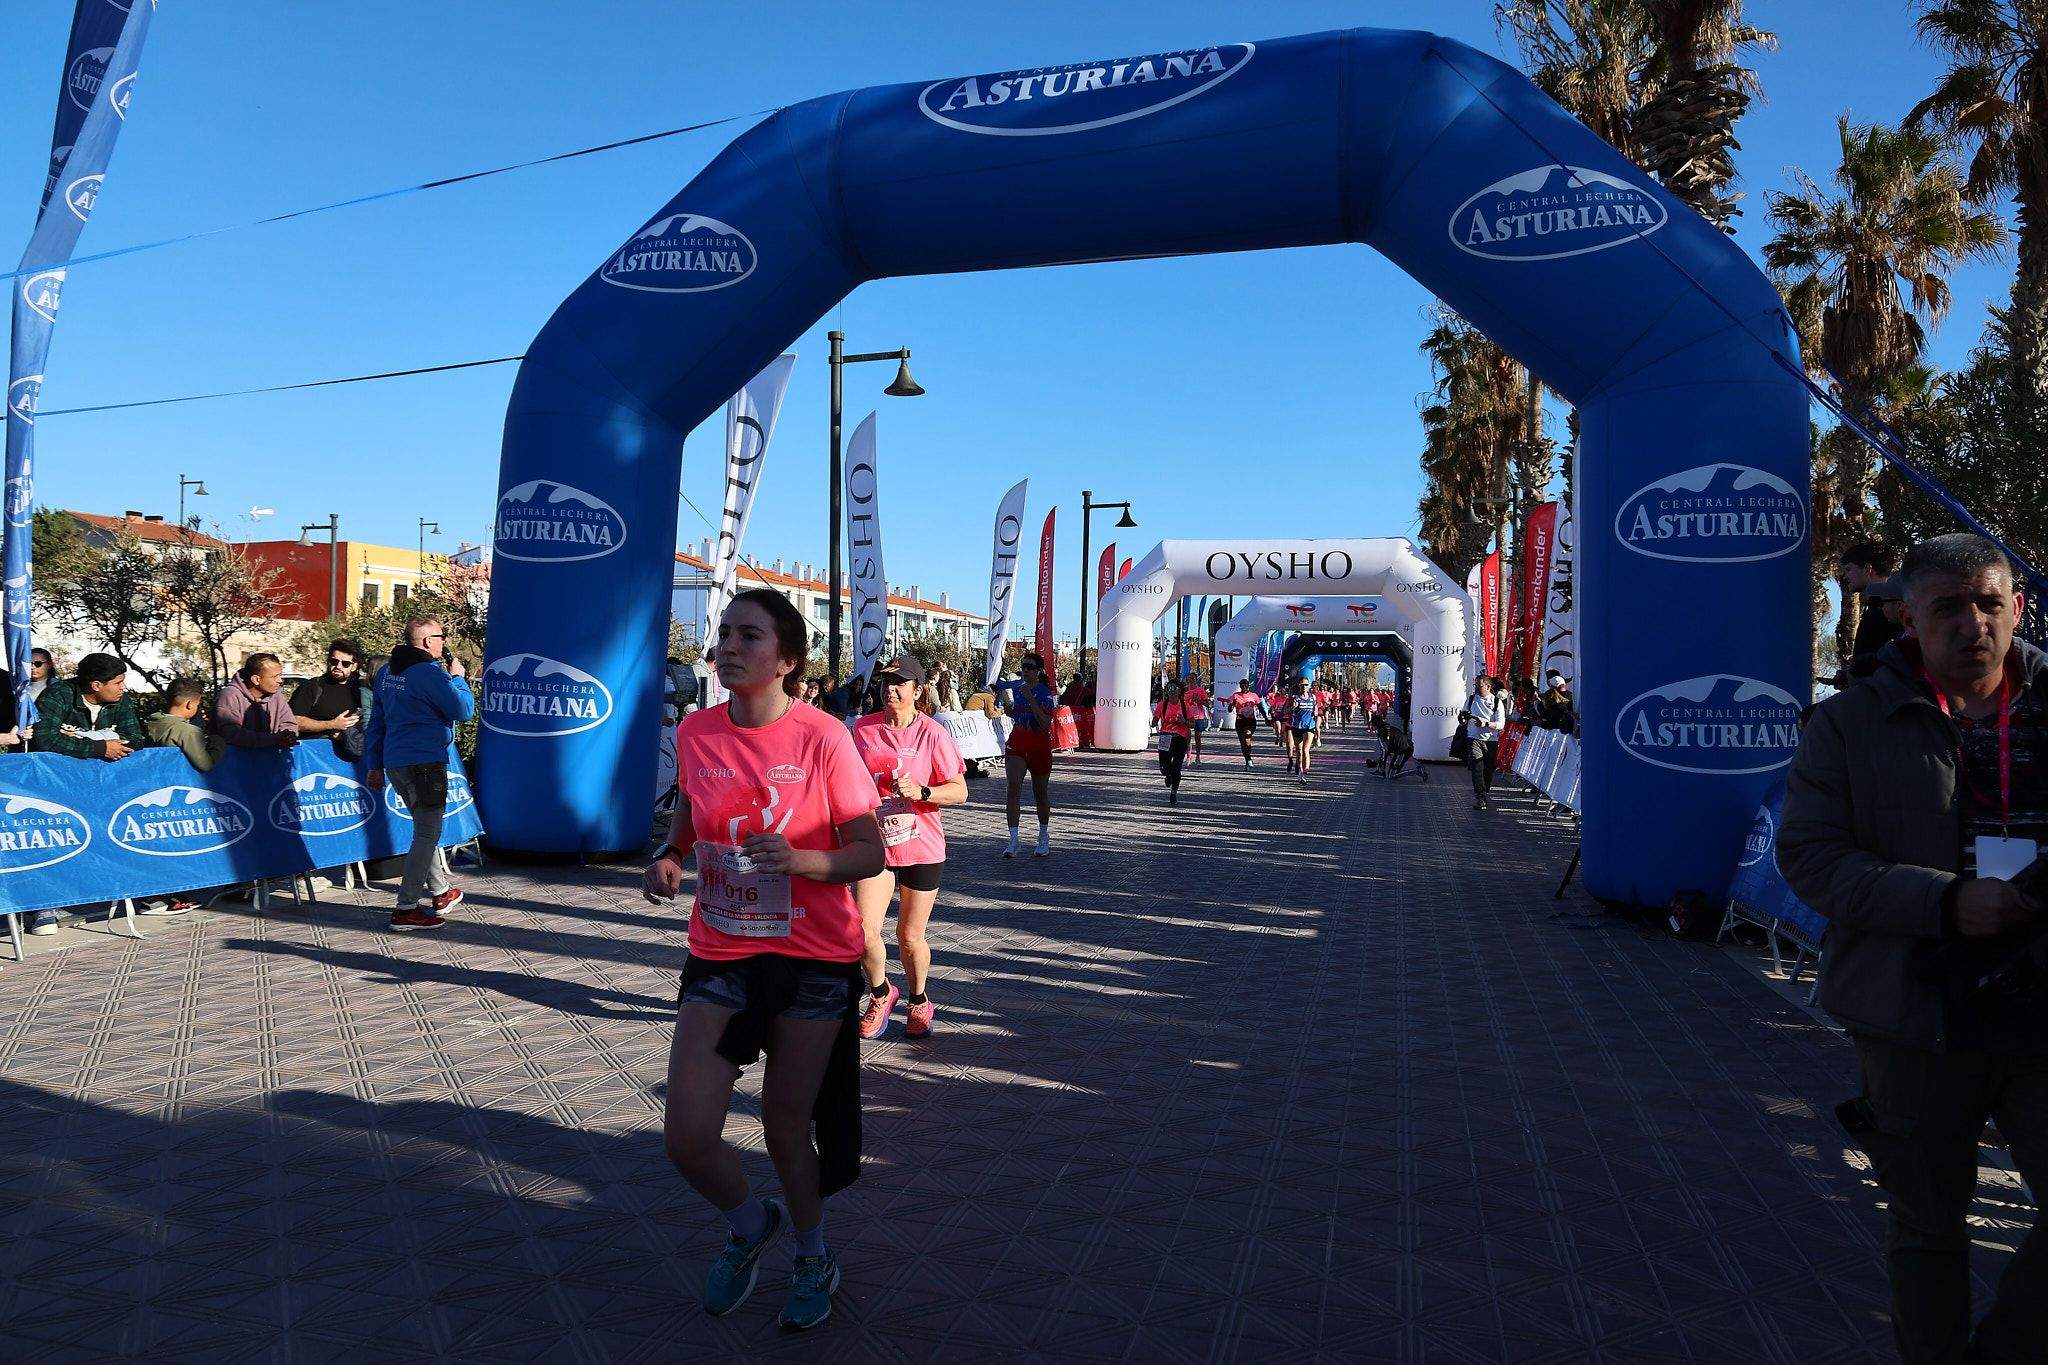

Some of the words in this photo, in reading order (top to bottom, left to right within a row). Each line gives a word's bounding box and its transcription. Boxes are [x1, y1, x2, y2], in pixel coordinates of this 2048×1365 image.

[939, 47, 1226, 112] ASTURIANA
[1497, 195, 1569, 212] CENTRAL
[1576, 192, 1643, 203] LECHERA
[1466, 204, 1655, 245] ASTURIANA
[633, 238, 678, 250] CENTRAL
[683, 238, 738, 248] LECHERA
[606, 250, 743, 276] ASTURIANA
[1661, 498, 1733, 510] CENTRAL
[1740, 497, 1796, 510] LECHERA
[505, 507, 547, 516] CENTRAL
[552, 508, 609, 521] LECHERA
[495, 510, 613, 546] ASTURIANA
[1628, 504, 1799, 541] ASTURIANA
[850, 463, 882, 660] OYSHO
[1206, 551, 1352, 580] OYSHO
[1530, 527, 1546, 617] Santander
[1122, 584, 1163, 594] OYSHO
[1396, 582, 1443, 593] OYSHO
[1101, 640, 1139, 650] OYSHO
[1421, 645, 1465, 655] OYSHO
[491, 680, 532, 690] CENTRAL
[538, 684, 595, 694] LECHERA
[481, 681, 599, 719] ASTURIANA
[1099, 697, 1137, 708] OYSHO
[1661, 708, 1733, 718] CENTRAL
[1740, 708, 1796, 718] LECHERA
[1628, 710, 1799, 748] ASTURIANA
[699, 768, 736, 779] OYSHO
[141, 810, 188, 820] CENTRAL
[277, 798, 371, 825] ASTURIANA
[14, 816, 70, 827] LECHERA
[122, 815, 246, 842] ASTURIANA
[726, 884, 758, 902] 016
[747, 923, 779, 932] Santander
